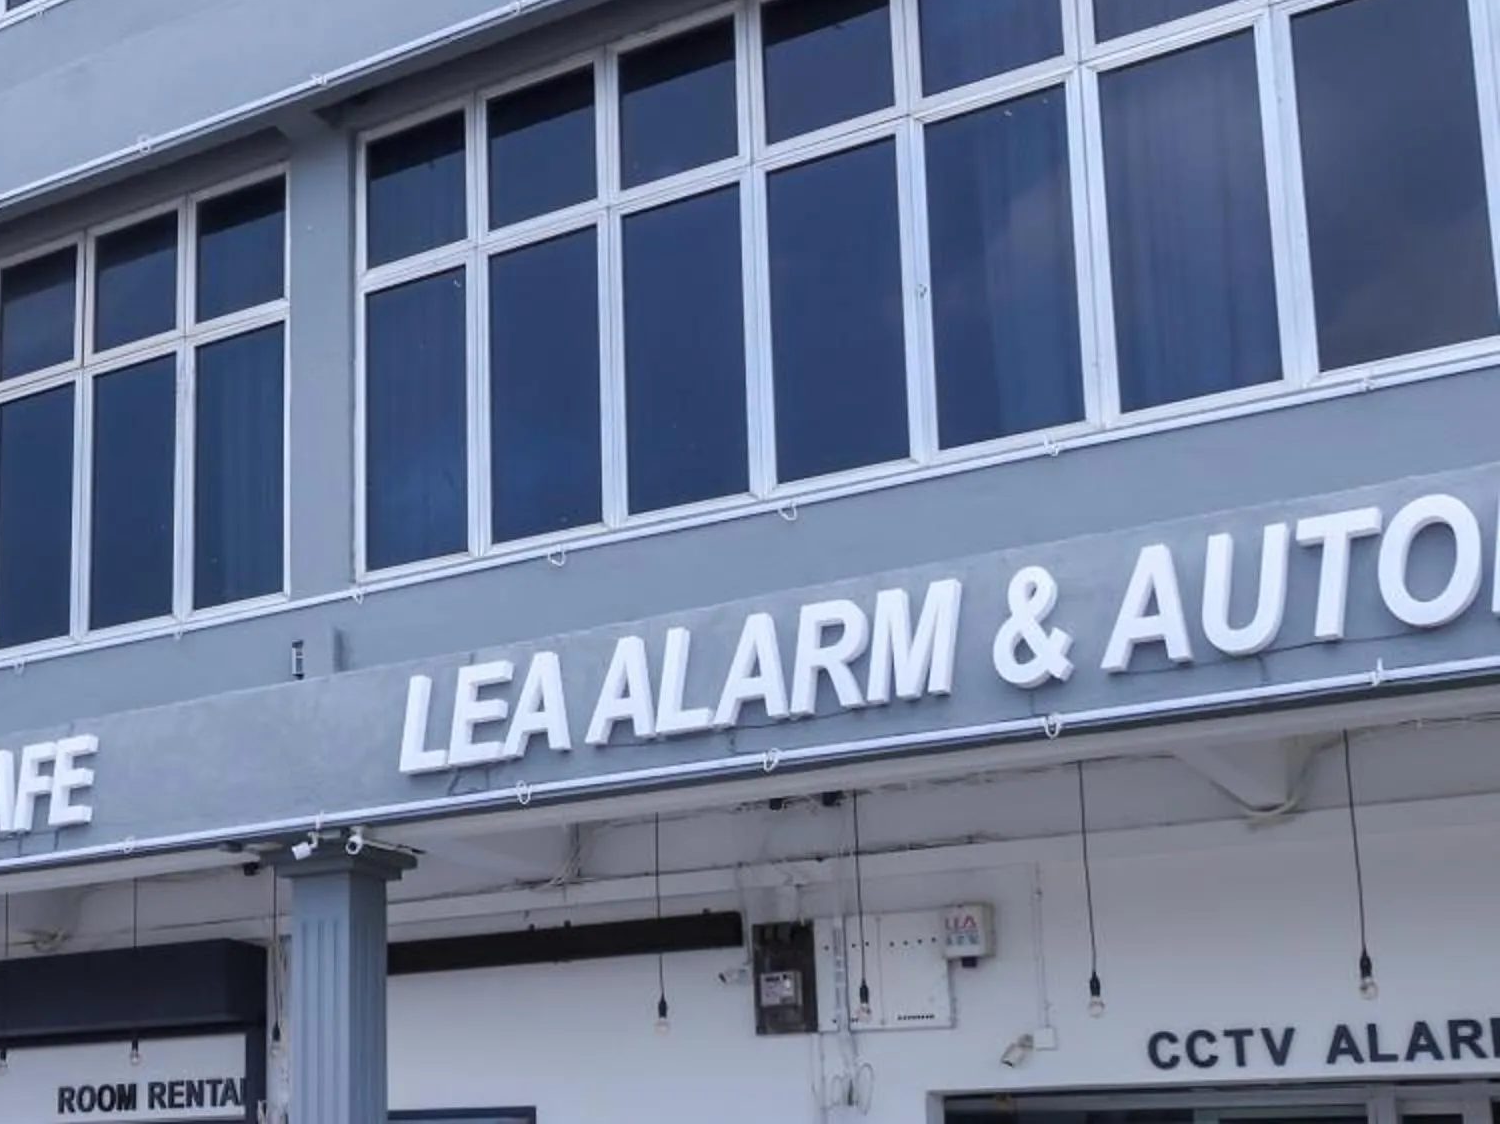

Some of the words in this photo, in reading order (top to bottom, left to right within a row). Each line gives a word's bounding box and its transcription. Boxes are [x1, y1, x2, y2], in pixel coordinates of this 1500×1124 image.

[397, 649, 573, 775] LEA
[583, 578, 964, 747] ALARM
[991, 564, 1076, 690] &
[1099, 493, 1500, 675] AUTO
[1146, 1027, 1296, 1071] CCTV
[1326, 1017, 1500, 1066] ALAR
[57, 1082, 138, 1115] ROOM
